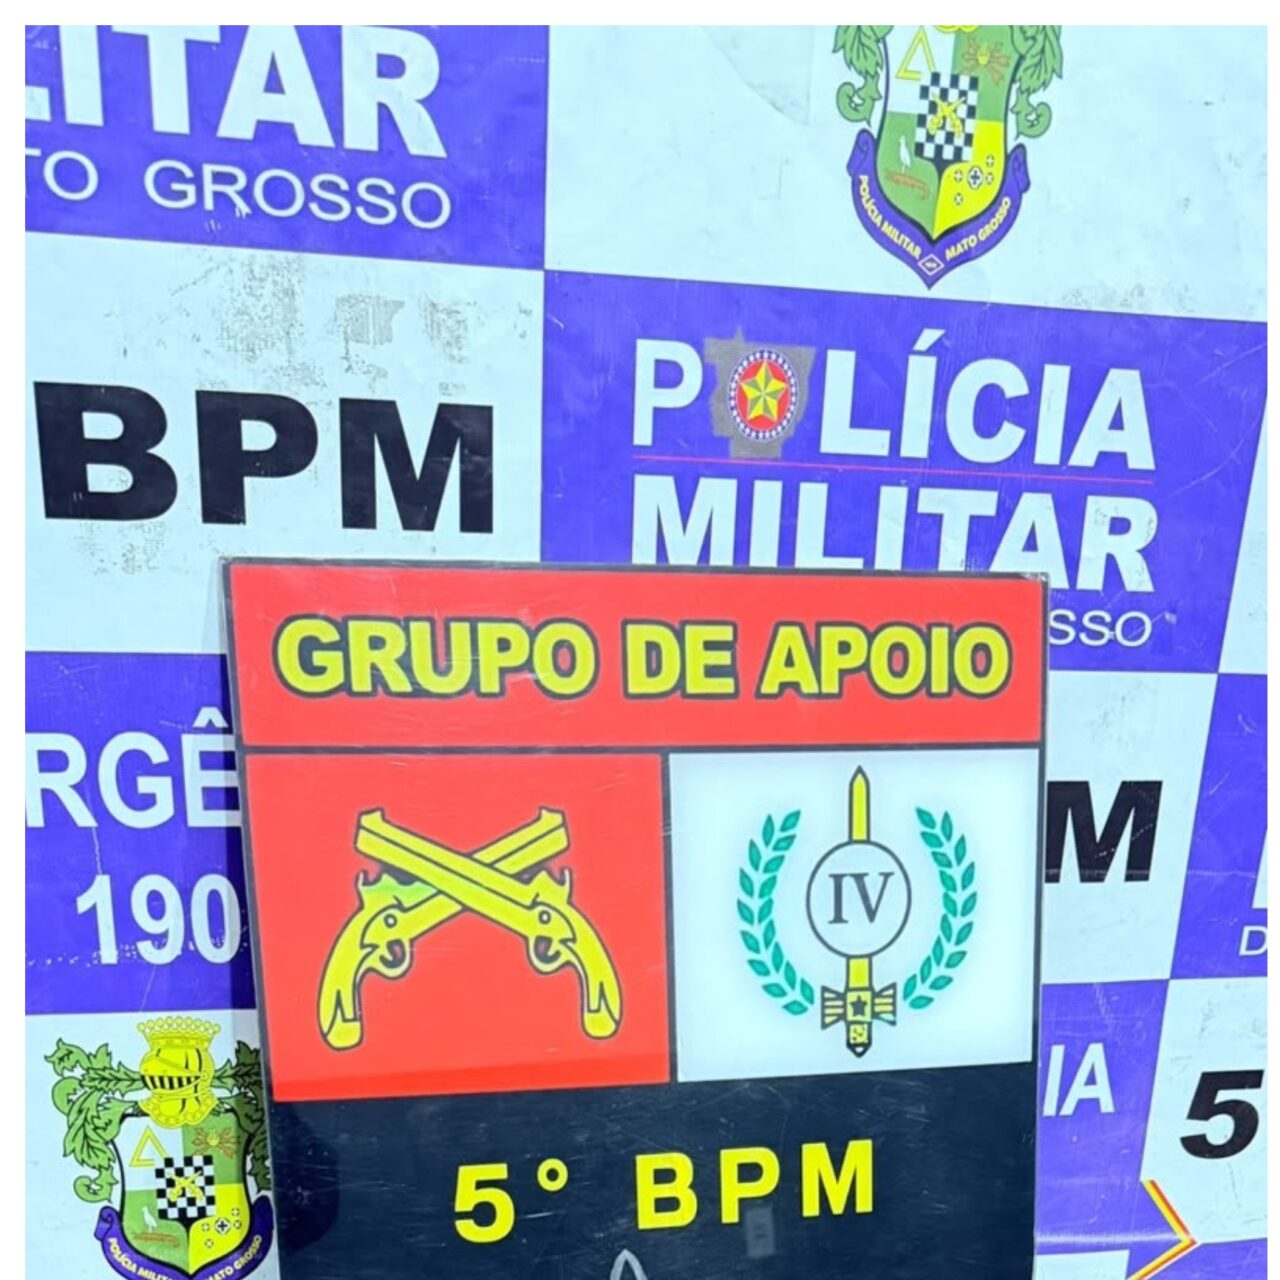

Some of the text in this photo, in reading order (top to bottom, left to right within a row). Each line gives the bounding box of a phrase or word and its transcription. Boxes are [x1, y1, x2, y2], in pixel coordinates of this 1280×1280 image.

[144, 160, 451, 230] GROSSO
[881, 220, 922, 260] MILITAR
[945, 235, 978, 261] MATO
[33, 381, 493, 534] BPM
[631, 474, 1158, 592] MILITAR
[273, 614, 1012, 700] GRUPO DE APOIO
[76, 874, 241, 965] 190
[827, 871, 895, 925] IV
[636, 1139, 873, 1230] BPM
